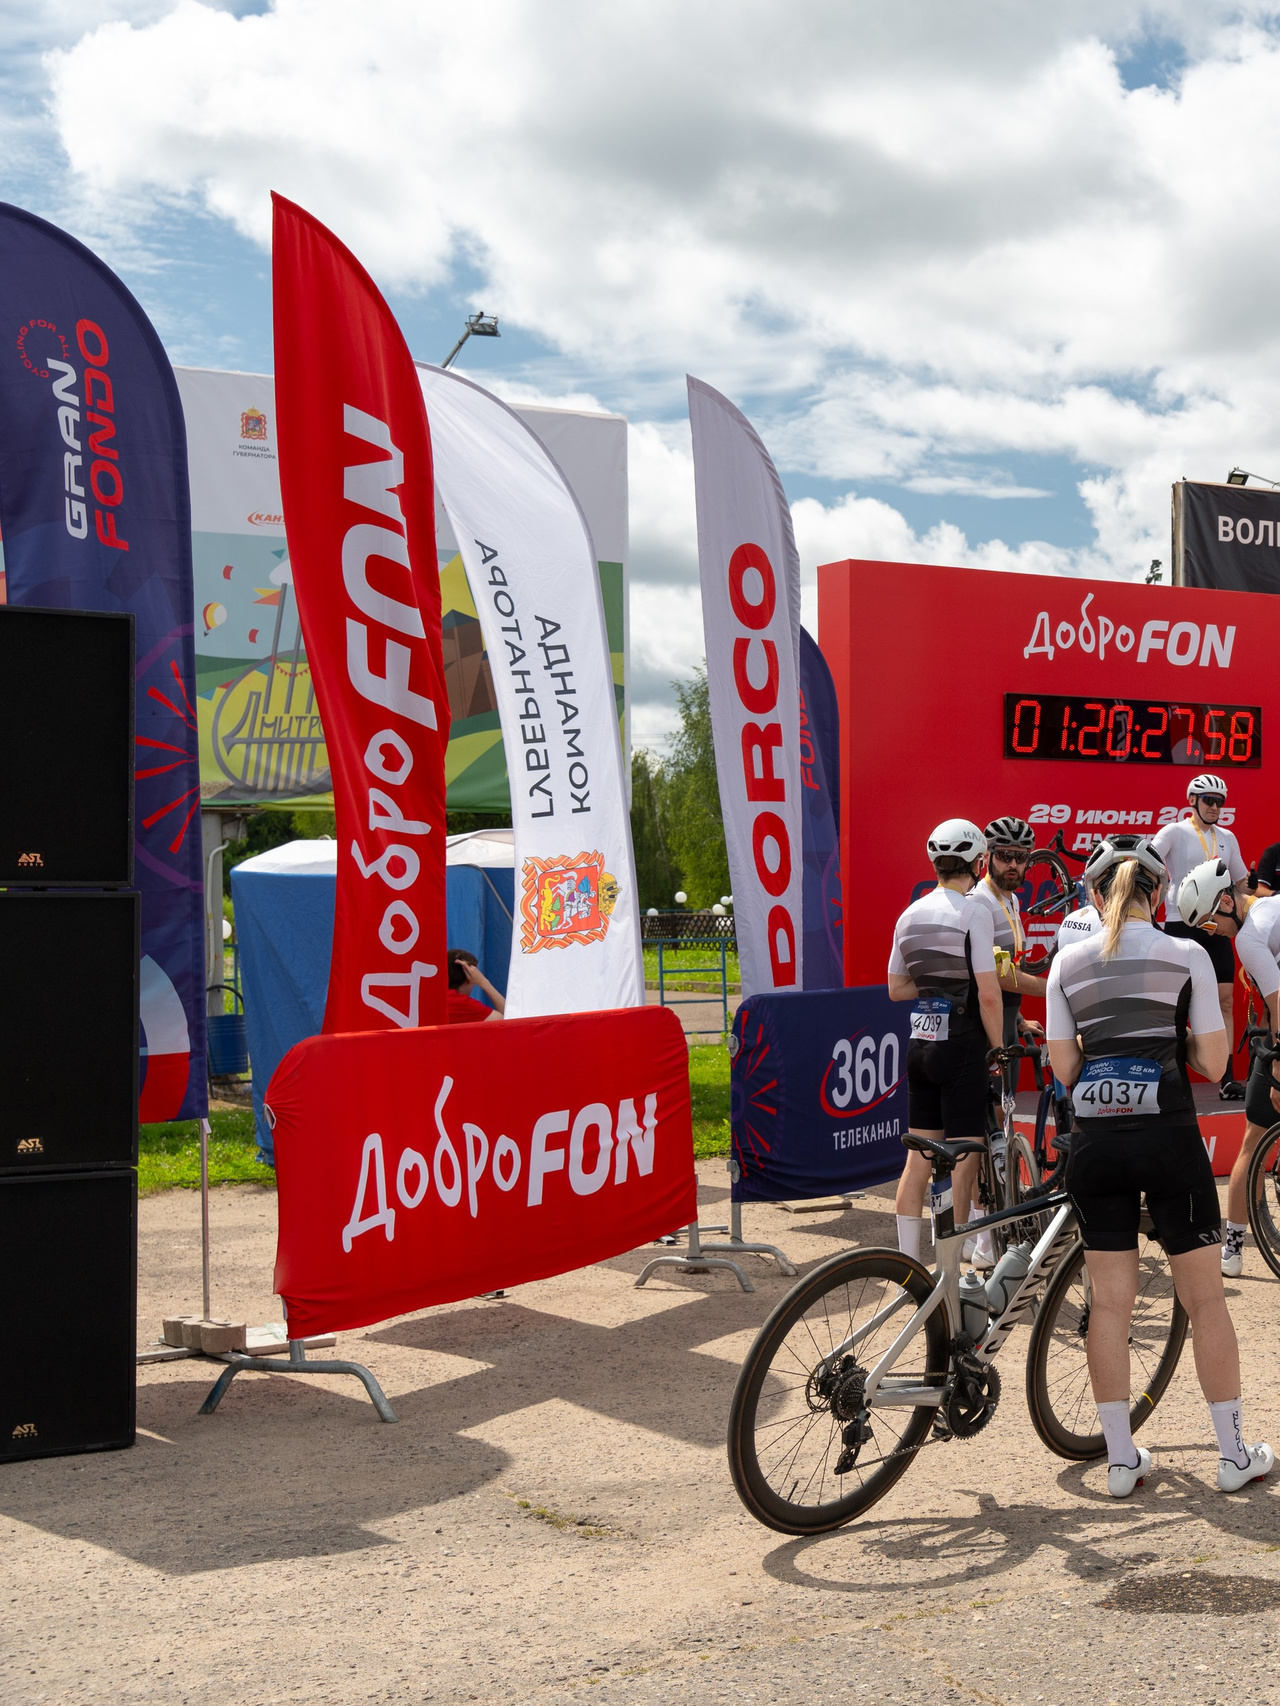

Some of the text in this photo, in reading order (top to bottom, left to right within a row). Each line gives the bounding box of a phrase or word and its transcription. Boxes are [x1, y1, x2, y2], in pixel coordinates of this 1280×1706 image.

[29, 319, 57, 333] FOR
[58, 334, 70, 360] ALL
[46, 357, 88, 540] GRAN
[76, 319, 129, 551] FONDO
[238, 444, 270, 452] КОМАНДА
[232, 450, 277, 459] ГУБЕРНАТОРА
[1023, 593, 1237, 669] ДоброFON
[729, 543, 796, 988] DORCO
[1028, 804, 1071, 823] 29
[1157, 807, 1236, 826] 205
[1063, 920, 1092, 932] RUSSIA
[914, 1015, 942, 1032] 4039
[832, 1032, 900, 1108] 360
[1130, 1064, 1143, 1072] 45
[1081, 1080, 1148, 1105] 4037
[833, 1118, 900, 1150] ТЕЛЕКАНАЛ
[342, 1076, 658, 1253] ДоброFON
